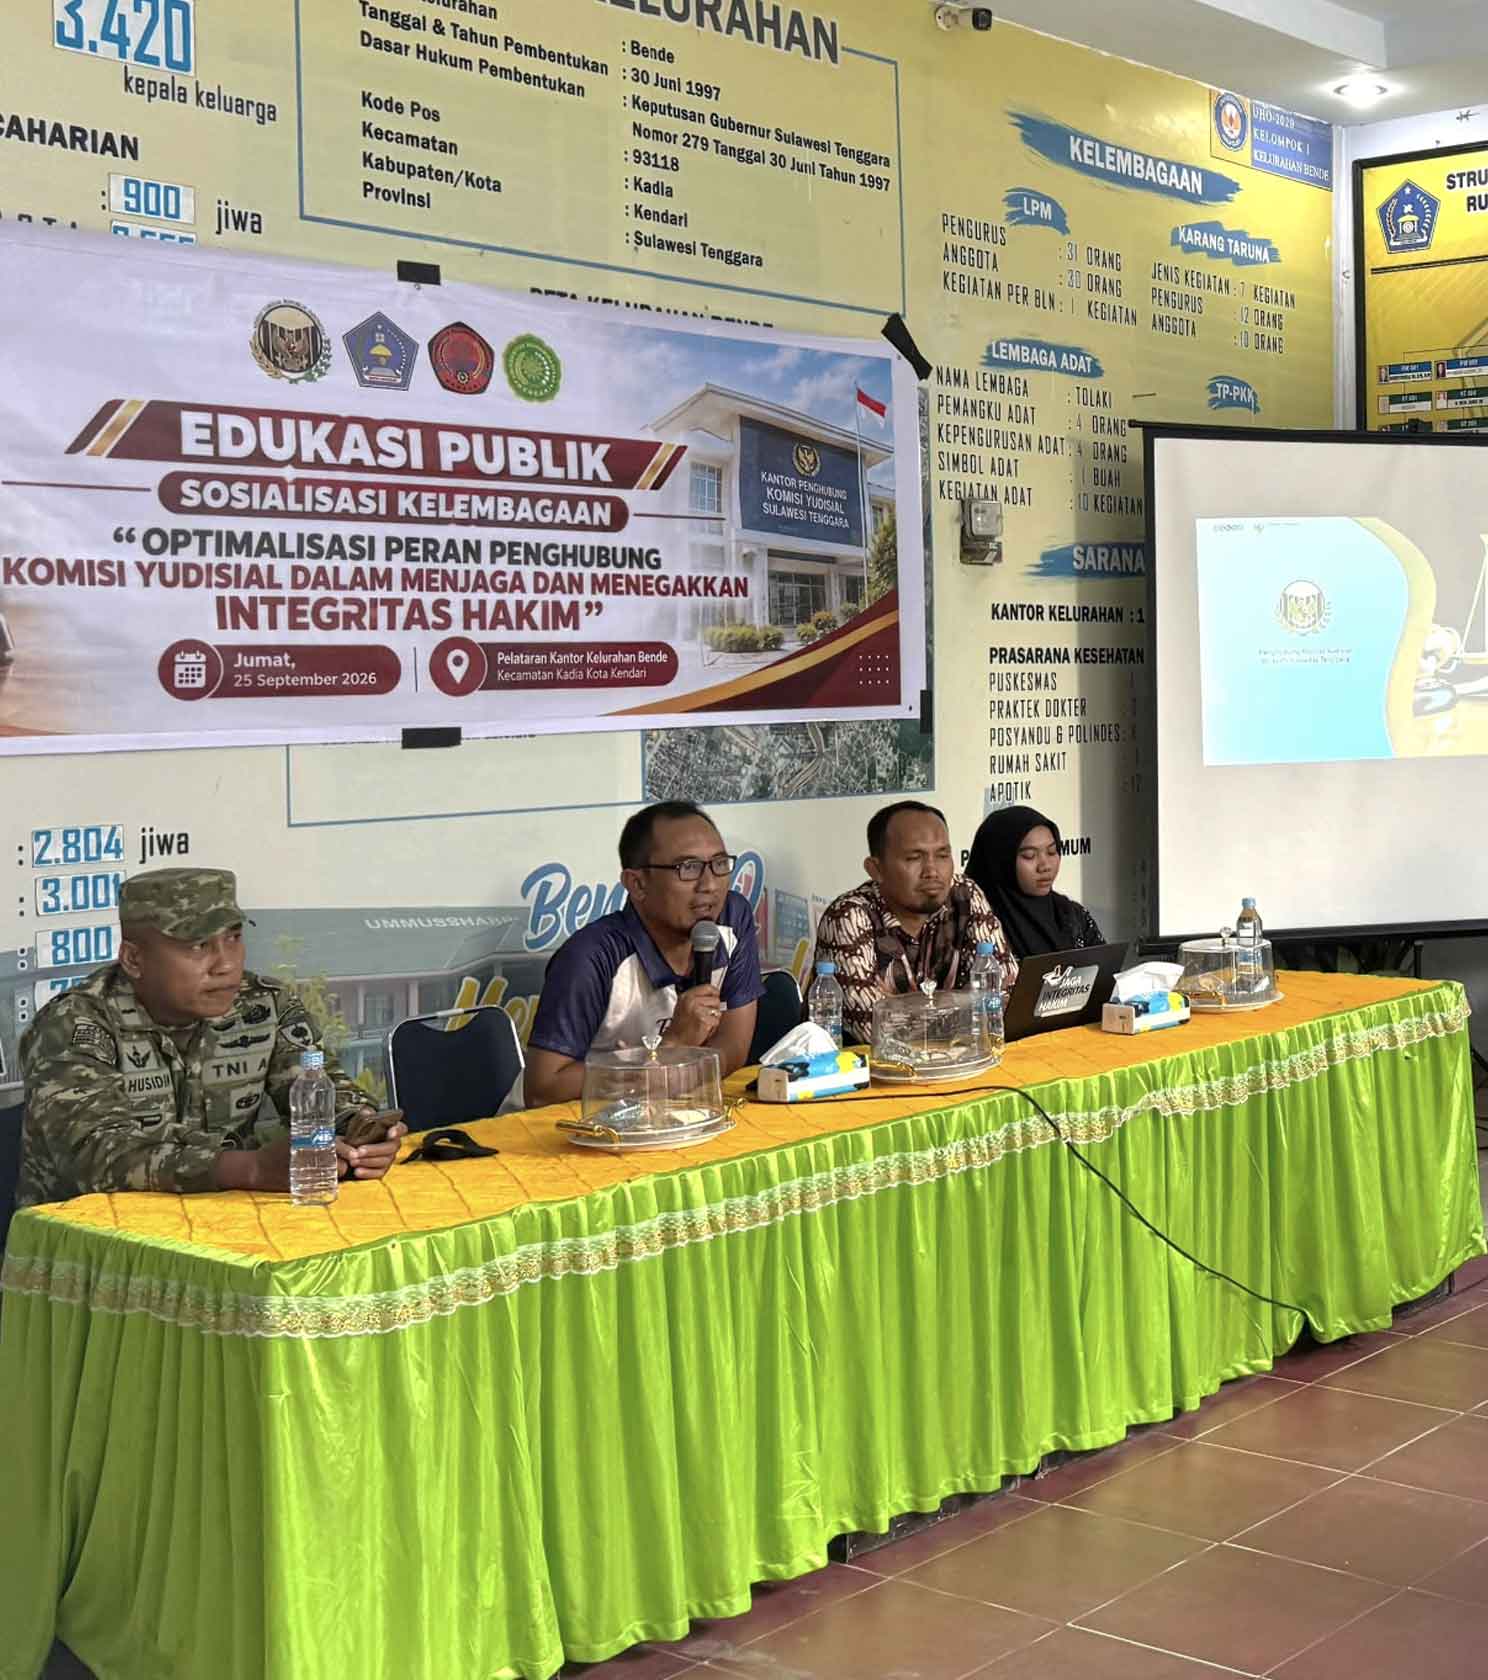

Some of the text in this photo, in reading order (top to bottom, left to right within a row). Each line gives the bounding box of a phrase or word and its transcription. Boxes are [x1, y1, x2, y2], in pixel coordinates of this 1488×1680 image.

[358, 1, 609, 76] Tanggal & Tahun Pembentukan
[631, 40, 675, 64] Bende
[360, 30, 586, 98] Dasar Hukum Pembentukan
[123, 66, 278, 125] kepala keluarga
[631, 67, 721, 102] 30 1997
[361, 91, 441, 123] Kode Pos
[361, 121, 459, 156] Kecamatan
[632, 94, 891, 169] Keputusan Gubernur Tenggara
[362, 151, 503, 194] Kabupaten/Kota
[632, 149, 680, 173] 93118
[633, 121, 891, 194] Nomor 279 Tanggal 30 Tahun 1997
[1069, 135, 1203, 195] KELEMBAGAAN
[633, 177, 674, 200] Kadia
[123, 178, 181, 220] 900
[216, 200, 263, 236] jiwa
[633, 204, 688, 229] Kendari
[1022, 197, 1053, 221] LPM
[633, 230, 764, 269] Sulawesi Tenggara
[941, 213, 1122, 272] PENGURUS ORANG
[1177, 226, 1271, 265] KARANG TARUNA
[942, 243, 1123, 299] ANGGOTA ORANG
[1151, 262, 1296, 310] JENIS KEGIATAN KEGIATAN
[942, 271, 1139, 328] KEGIATAN PER KEGIATAN
[1151, 288, 1285, 331] PENGURUS ORANG
[1151, 315, 1285, 356] ANGGOTA ORANG
[991, 340, 1094, 375] LEMBAGA ADAT
[935, 365, 1112, 410] NAMA LEMBAGA TOLAKI
[1215, 381, 1255, 405] TP-PKK
[936, 394, 1127, 438] PEMANGKU ADAT ORANG
[180, 410, 615, 483] EDUKASI PUBLIK
[936, 423, 1128, 464] KEPENGURUSAN ADAT ORANG
[761, 471, 798, 488] KANTOR
[937, 451, 1121, 488] SIMBOL ADAT BUAH
[180, 478, 612, 528] SOSIALISASI KELEMBAGAAN
[762, 502, 808, 521] SULAWESI
[766, 486, 846, 514] KOMISI YUDISIAL
[1003, 487, 1033, 508] ADAT
[384, 534, 481, 566] PERAN
[489, 539, 662, 571] PENGHUBUNG
[1072, 544, 1146, 573] SARANA
[2, 556, 749, 600] KOMISI YUDISIAL DALAM MENJAGA DAN MENEGAKKAN
[215, 595, 453, 633] INTEGRITAS
[991, 602, 1124, 625] KANTOR KELURAHAN
[232, 651, 297, 670] Jumat,
[497, 649, 669, 666] Pelataran Kantor Kelurahan Bende
[497, 666, 648, 682] Kecamatan Kadia Kota Kendari
[989, 646, 1145, 666] PRASARANA KESEHATAN
[233, 669, 378, 692] 25 September 2026
[989, 671, 1058, 693] PUSKESMAS
[989, 697, 1088, 721] PRAKTEK DOKTER
[989, 722, 1121, 748] POSYANDU POLINDES
[989, 751, 1067, 776] RUMAH SAKIT
[989, 781, 1032, 804] APOTIK
[33, 826, 190, 866] 2.804 jiwa
[51, 925, 113, 966] 800
[211, 1060, 248, 1078] TNI
